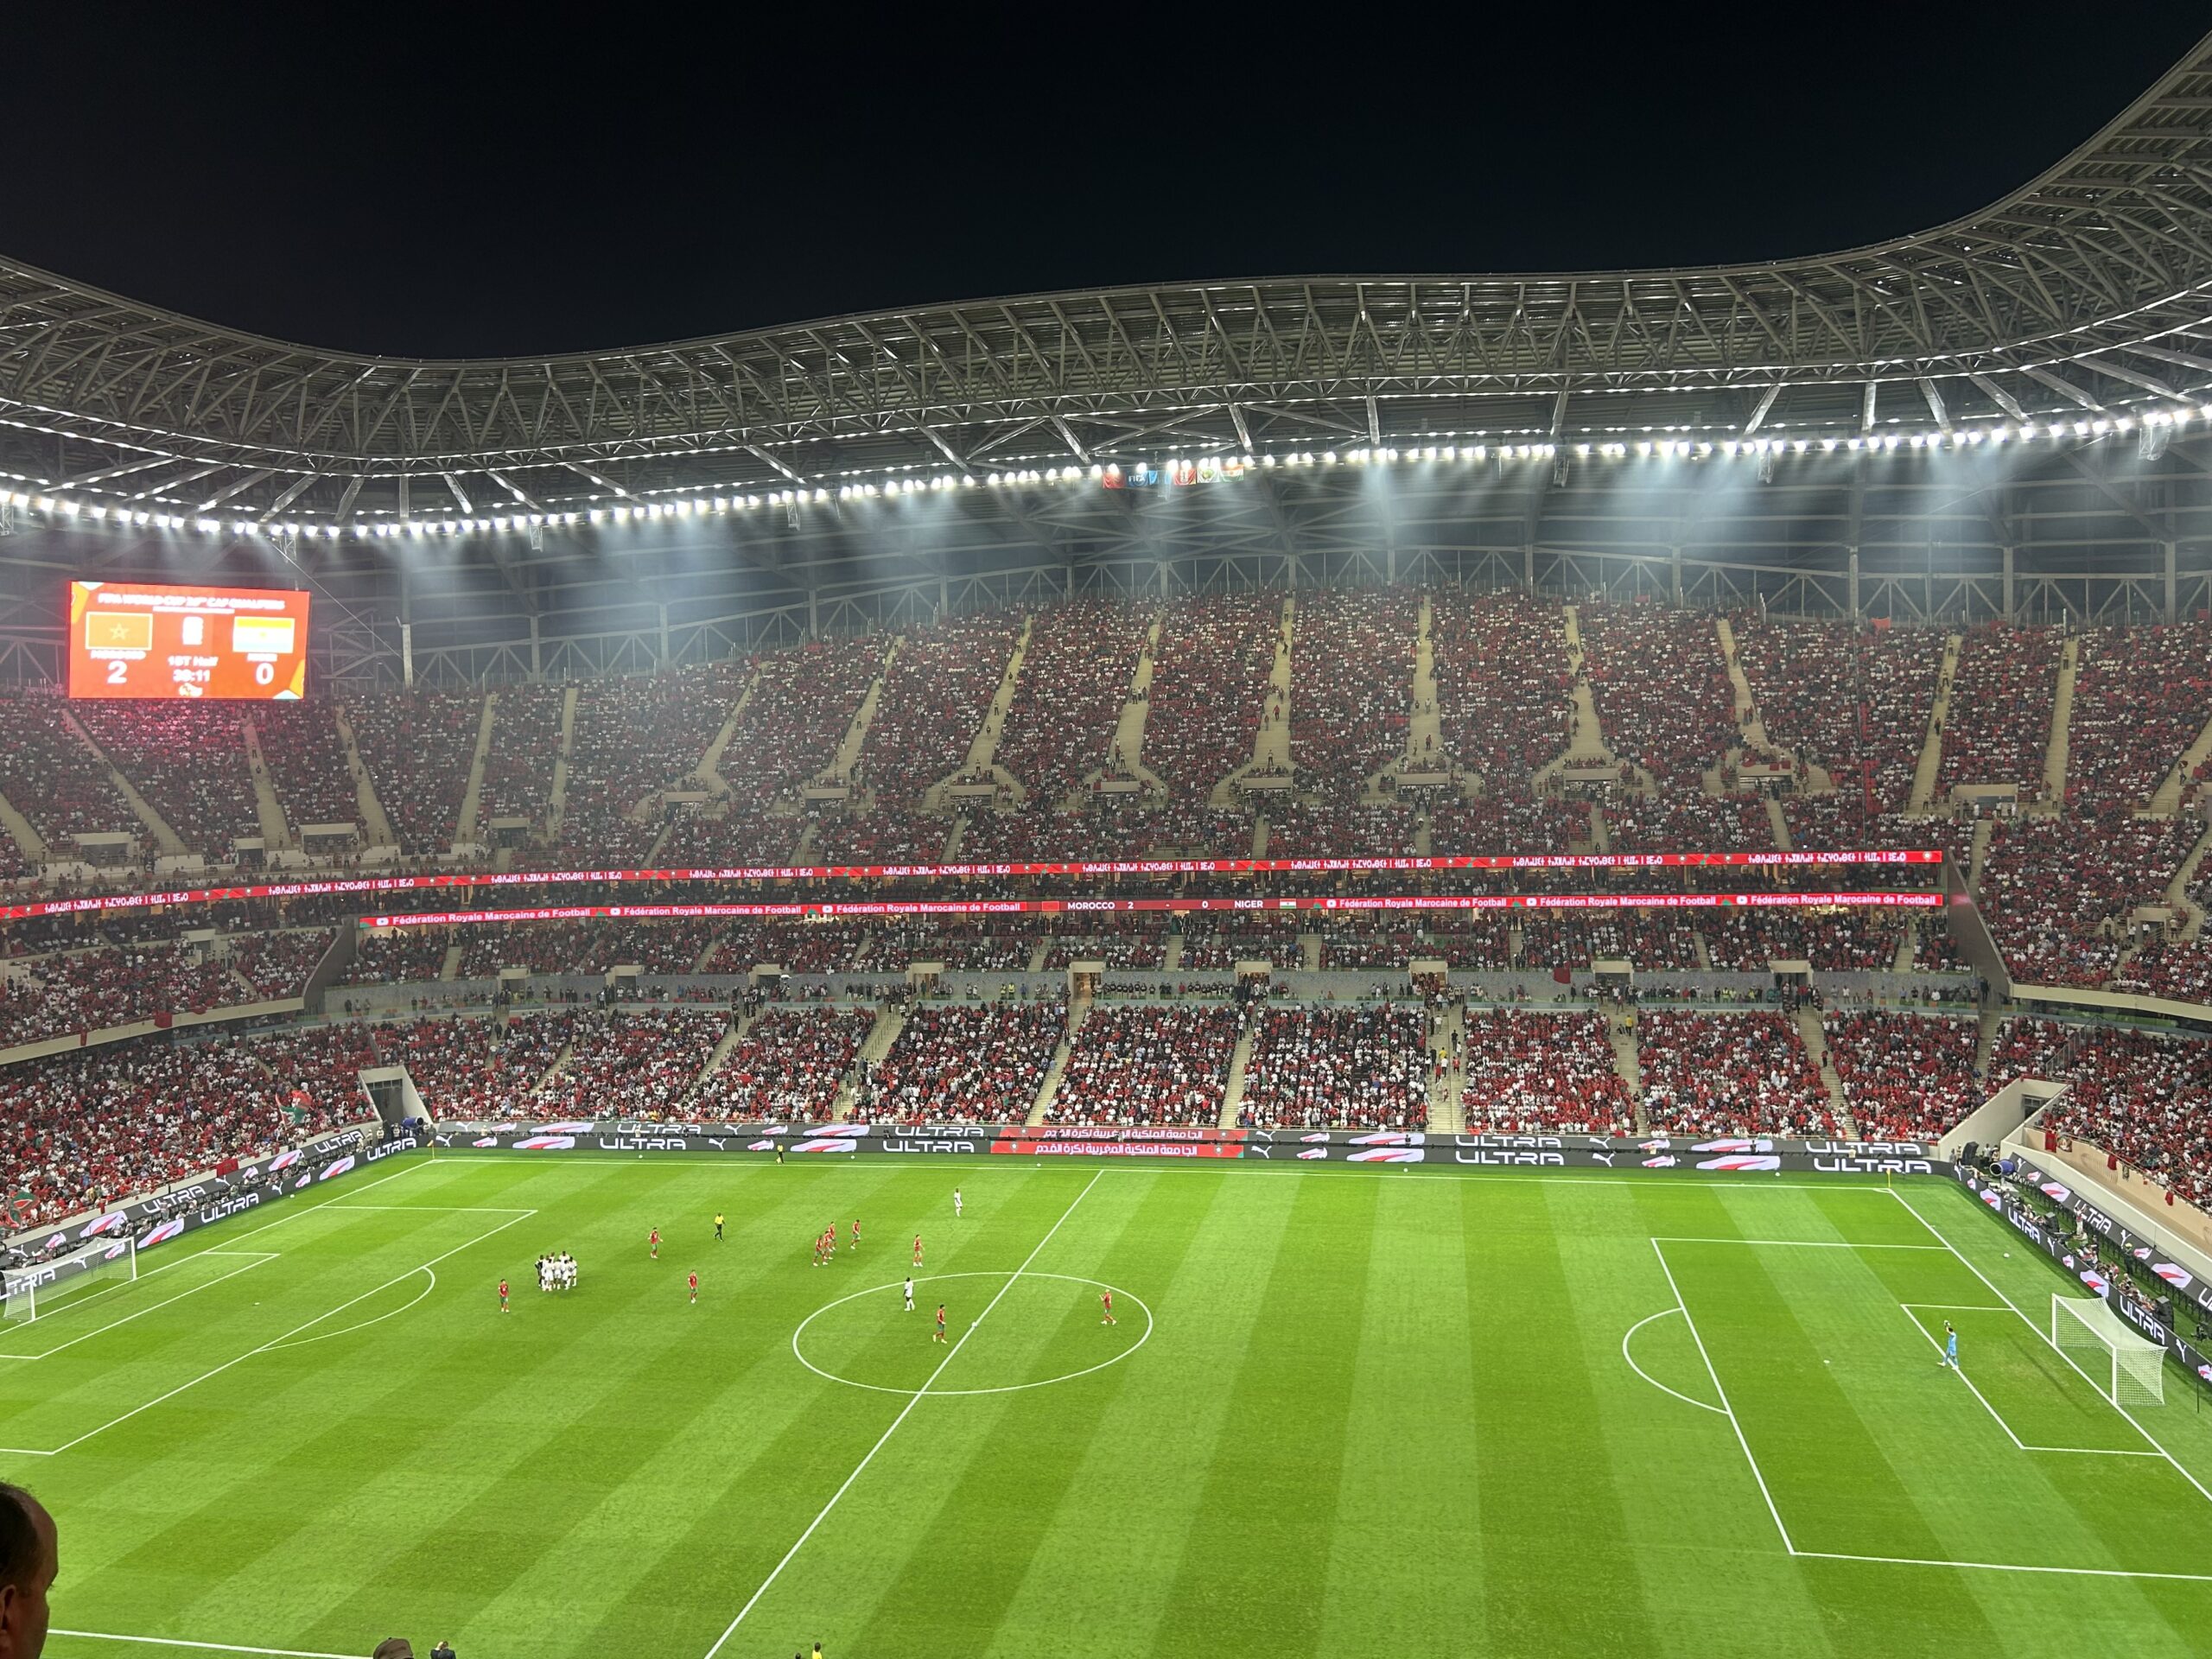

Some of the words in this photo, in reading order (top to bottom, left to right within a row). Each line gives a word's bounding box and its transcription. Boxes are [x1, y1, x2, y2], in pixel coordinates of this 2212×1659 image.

[107, 661, 127, 683] 2
[256, 663, 274, 685] 0
[1068, 901, 1115, 909] MOROCCO
[1385, 899, 1412, 908] Royale
[1472, 898, 1506, 906] Football
[1540, 898, 1585, 906] Fédération
[1588, 897, 1617, 906] Royale
[1680, 897, 1715, 905] Football
[1751, 896, 1798, 904] Fédération
[1801, 895, 1832, 905] Royale
[1834, 895, 1880, 904] Marocaine
[1897, 895, 1935, 904] Football
[672, 907, 702, 915] Royale
[887, 904, 917, 913] Royale
[393, 915, 445, 924] Fédération
[448, 913, 482, 922] Royale
[485, 912, 534, 920] Marocaine
[617, 1124, 701, 1134] ULTRA
[895, 1126, 984, 1137] ULTRA
[315, 1130, 364, 1153] ULTRA
[600, 1138, 686, 1150] ULTRA
[883, 1140, 974, 1152] ULTRA
[1455, 1135, 1562, 1147] ULTRA
[367, 1138, 416, 1160] ULTRA
[1063, 1143, 1084, 1154] لكرة
[1805, 1141, 1921, 1155] ULTRA
[1456, 1151, 1564, 1165] ULTRA
[1814, 1158, 1931, 1173] ULTRA
[142, 1185, 206, 1214] ULTRA
[201, 1193, 259, 1223] ULTRA
[2008, 1207, 2040, 1244] ULTRA
[2120, 1295, 2165, 1345] ULTRA
